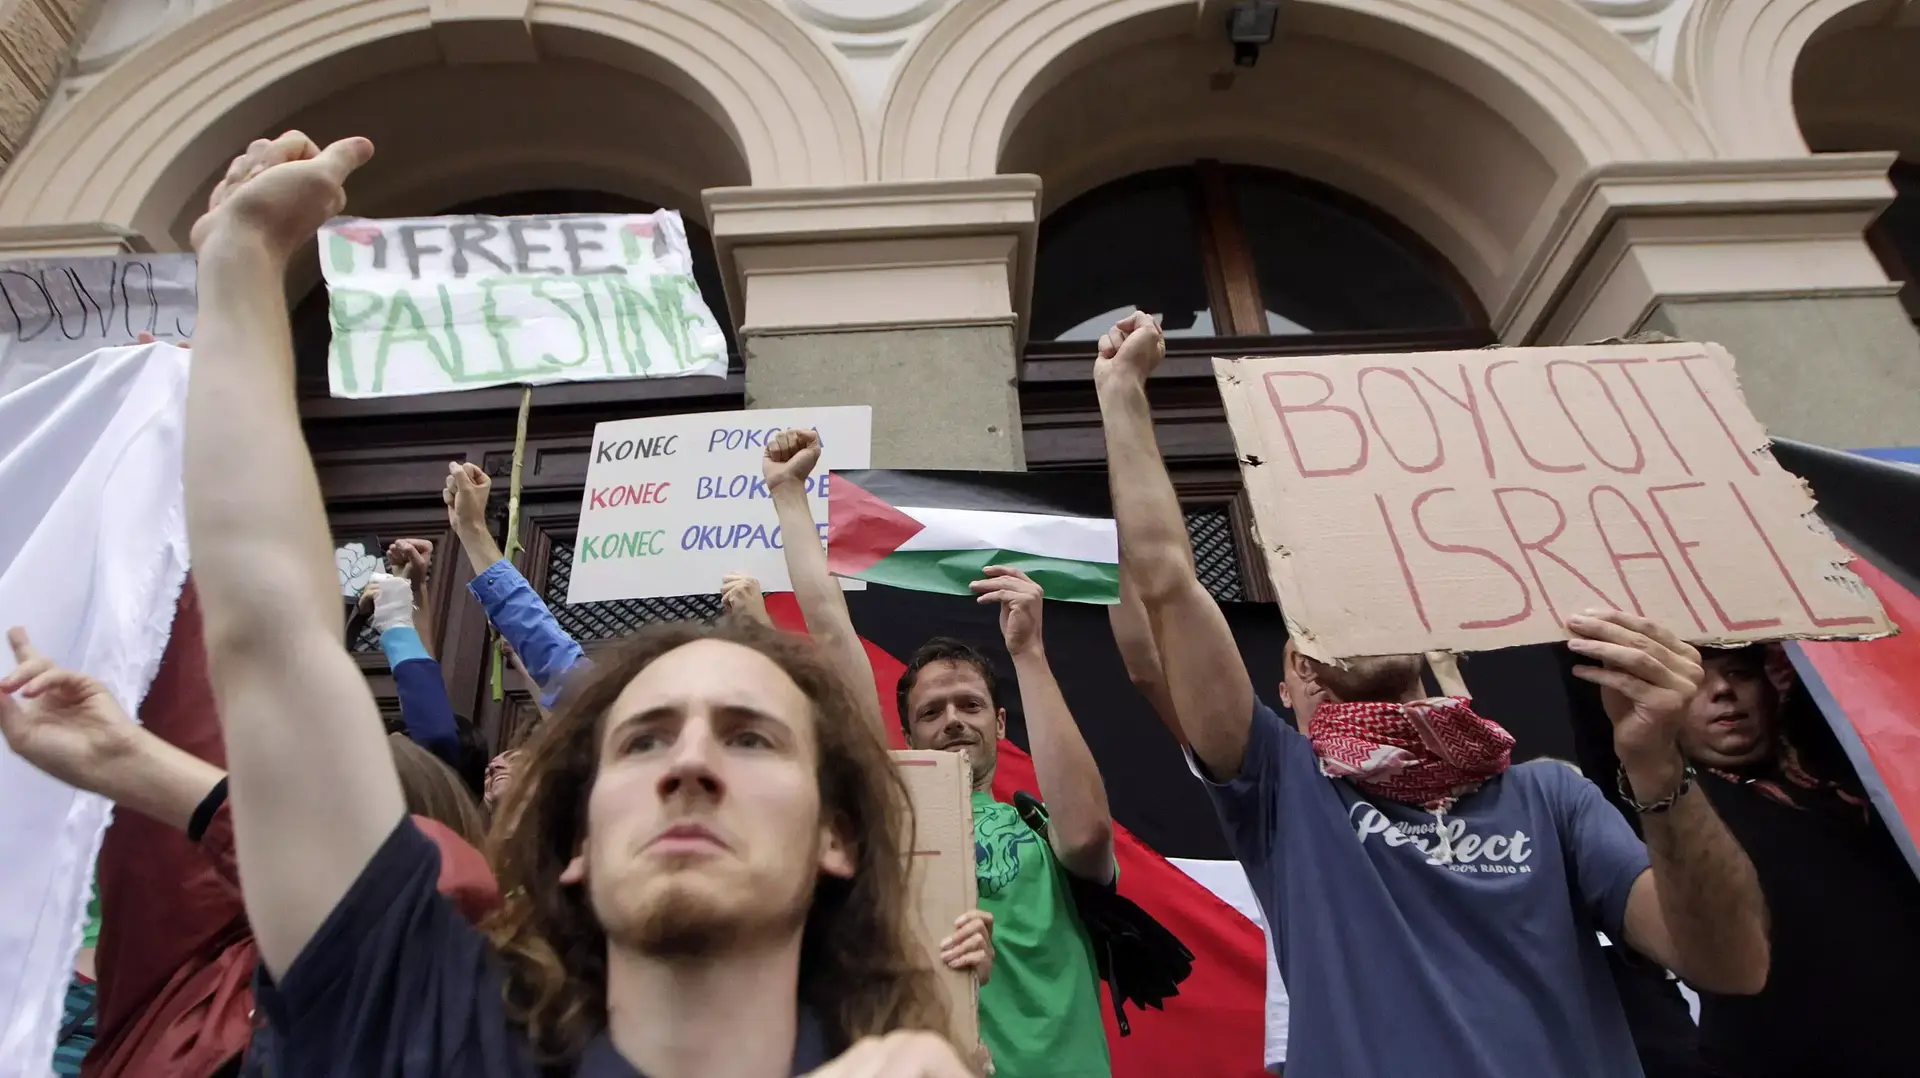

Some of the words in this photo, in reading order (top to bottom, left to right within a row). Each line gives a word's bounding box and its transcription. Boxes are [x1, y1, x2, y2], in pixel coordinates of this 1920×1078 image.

[400, 222, 627, 279] FREE
[331, 274, 720, 392] PALESTINE
[1262, 354, 1762, 478] BOYCOTT
[596, 435, 679, 464] KONEC
[589, 482, 671, 510] KONEC
[697, 474, 829, 500] BLOKDE
[581, 530, 665, 563] KONEC
[1374, 481, 1875, 633] ISRAEL
[1393, 821, 1437, 835] Almos
[1480, 864, 1517, 874] RADIO
